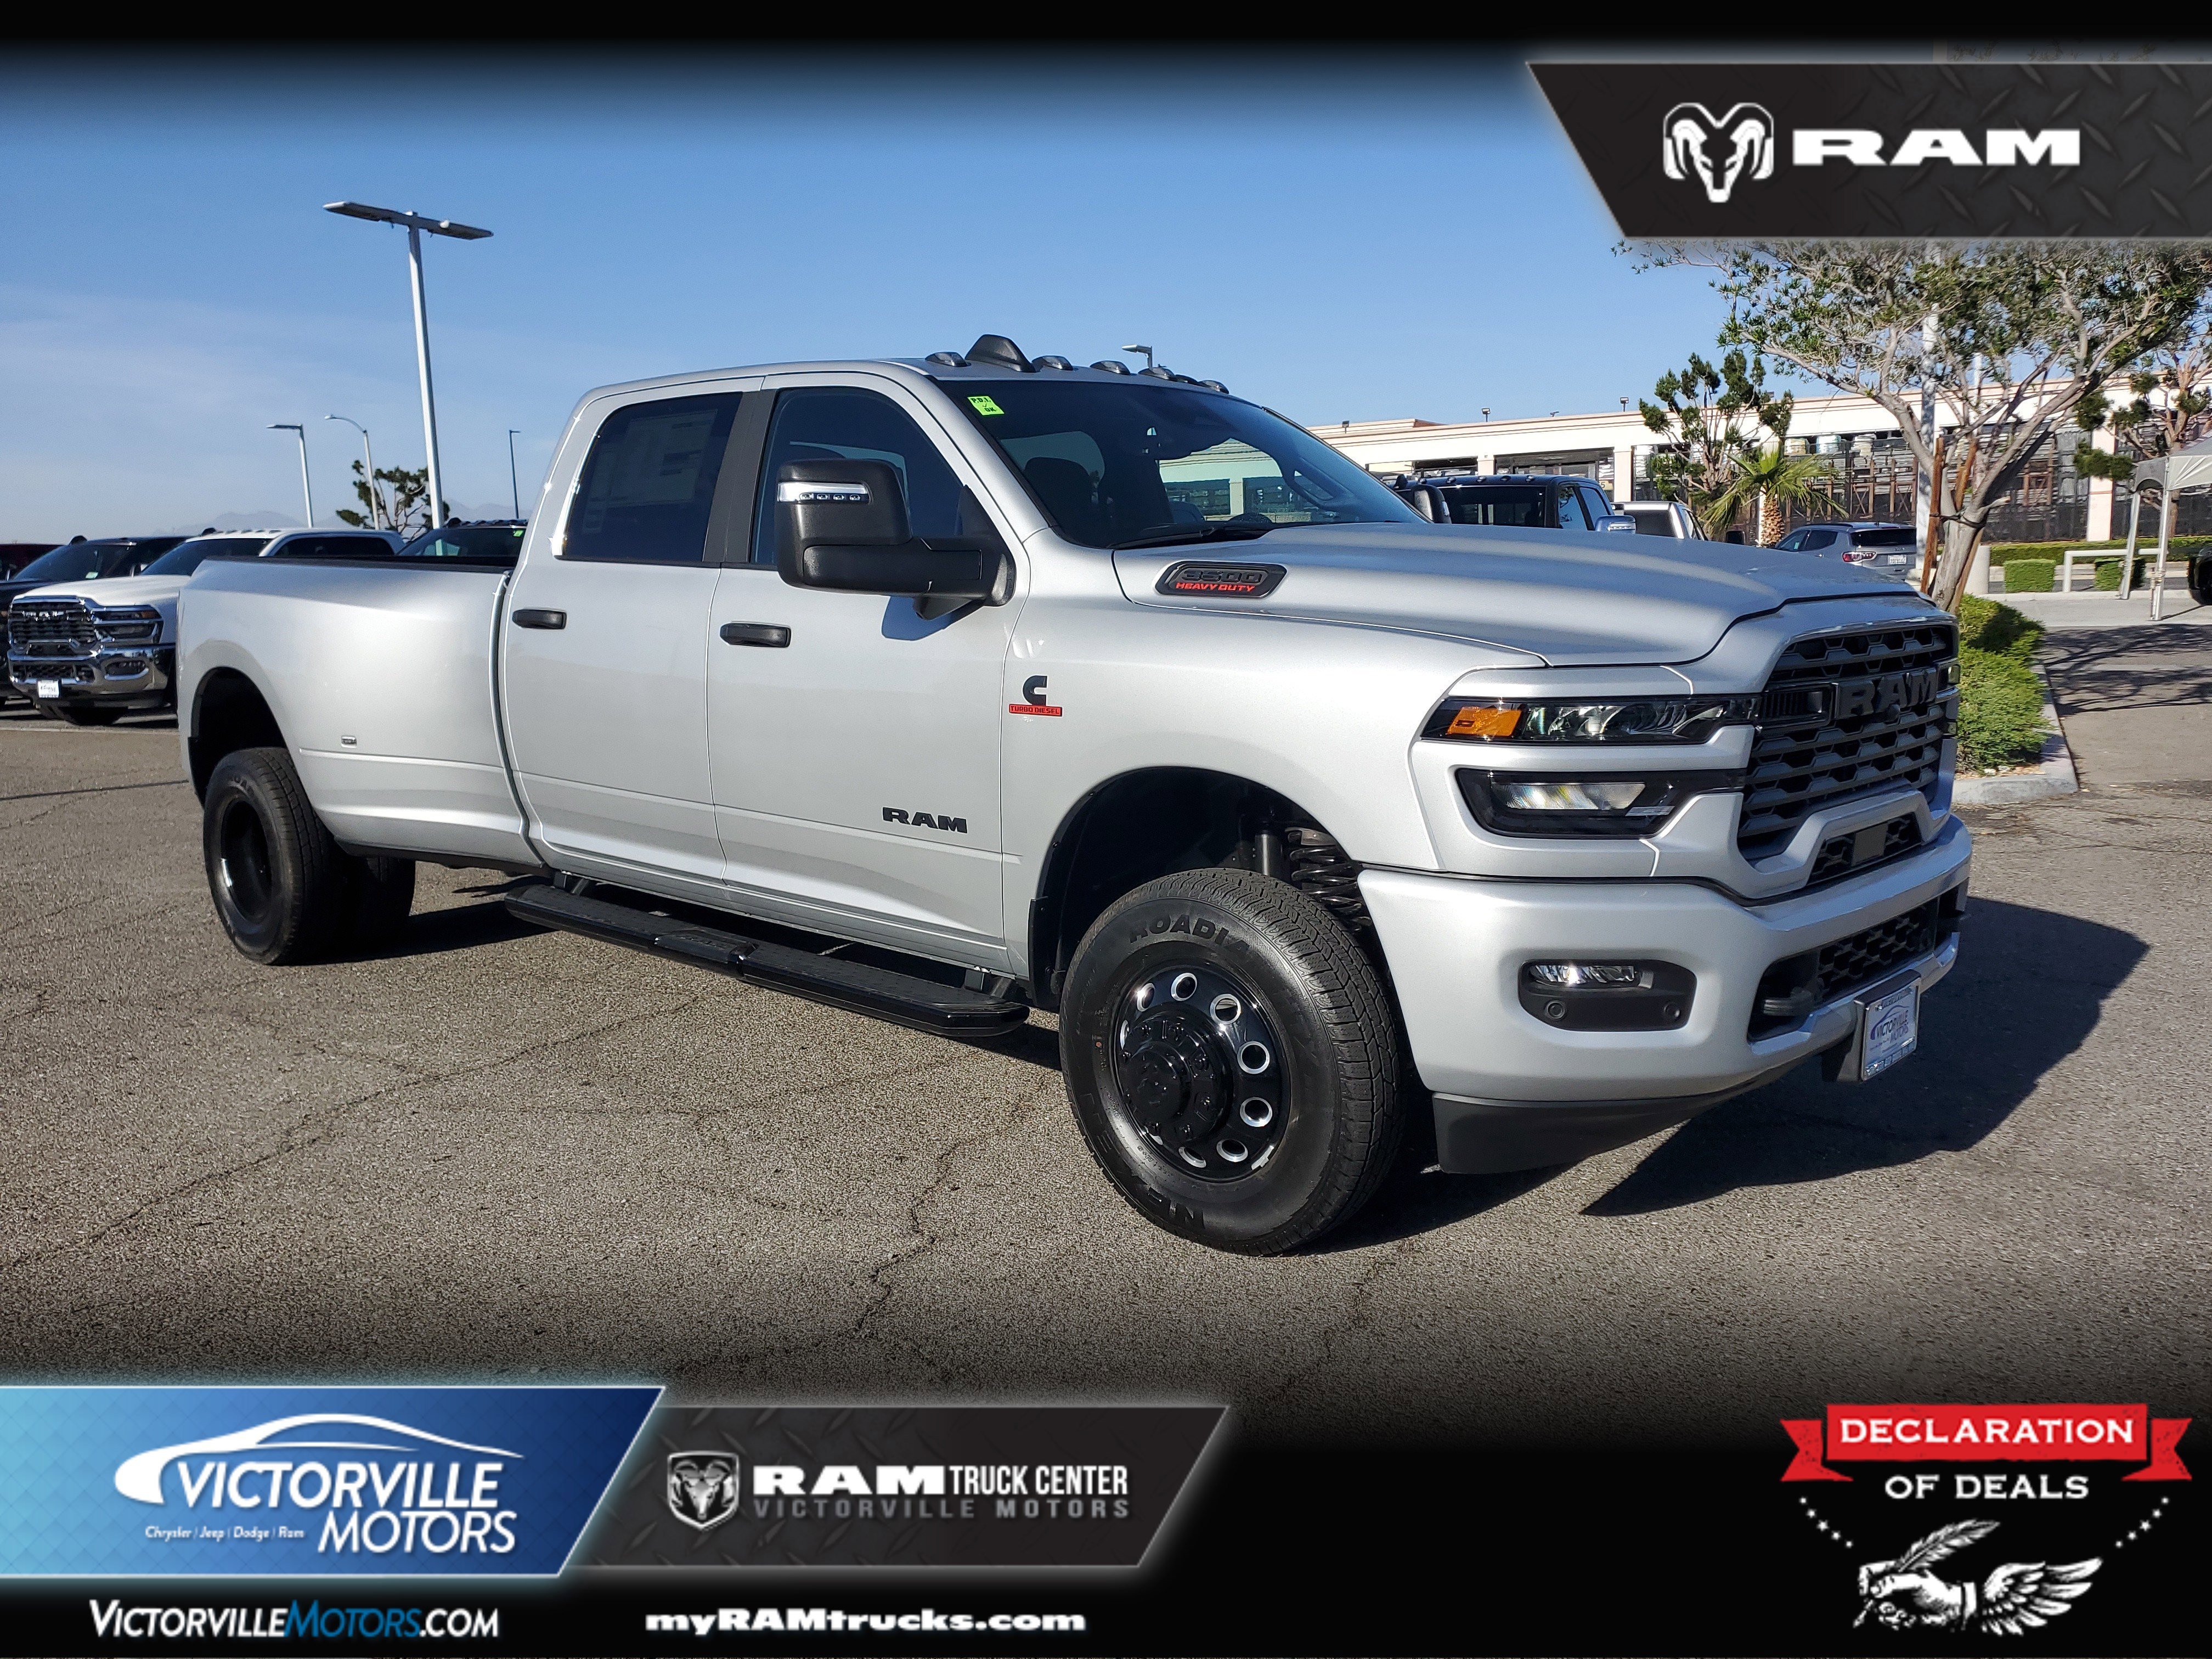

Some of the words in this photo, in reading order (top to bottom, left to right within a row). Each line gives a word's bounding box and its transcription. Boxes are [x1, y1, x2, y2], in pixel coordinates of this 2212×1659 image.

[1176, 582, 1217, 590] HEAVY
[1182, 570, 1262, 583] 3500
[1838, 669, 1938, 718] RAM
[882, 806, 968, 834] RAM
